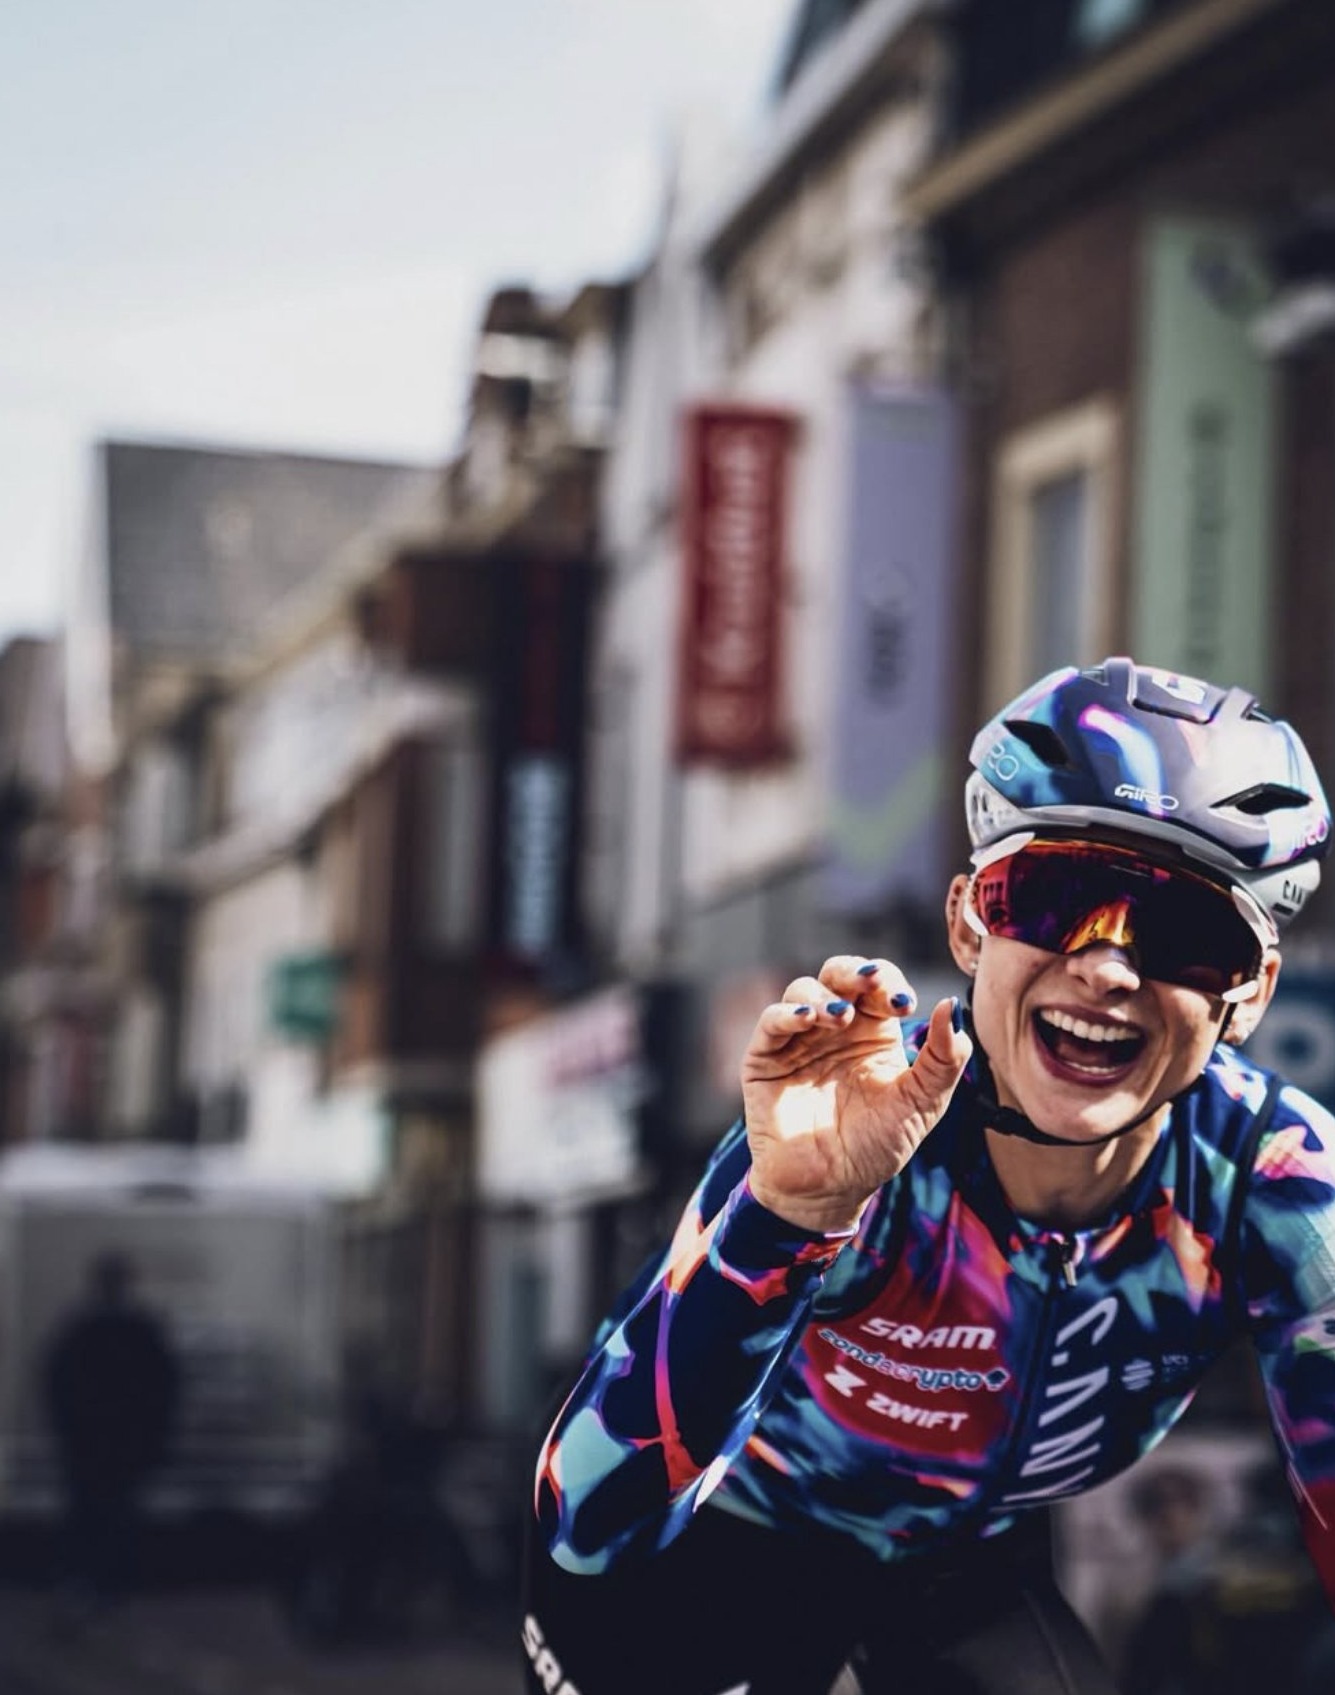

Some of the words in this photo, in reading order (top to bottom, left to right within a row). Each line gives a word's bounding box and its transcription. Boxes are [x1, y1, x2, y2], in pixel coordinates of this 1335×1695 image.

[817, 1327, 983, 1392] zondacrypto
[858, 1316, 998, 1351] SRAM
[865, 1392, 970, 1432] ZWIFT
[989, 1297, 1119, 1513] CANY
